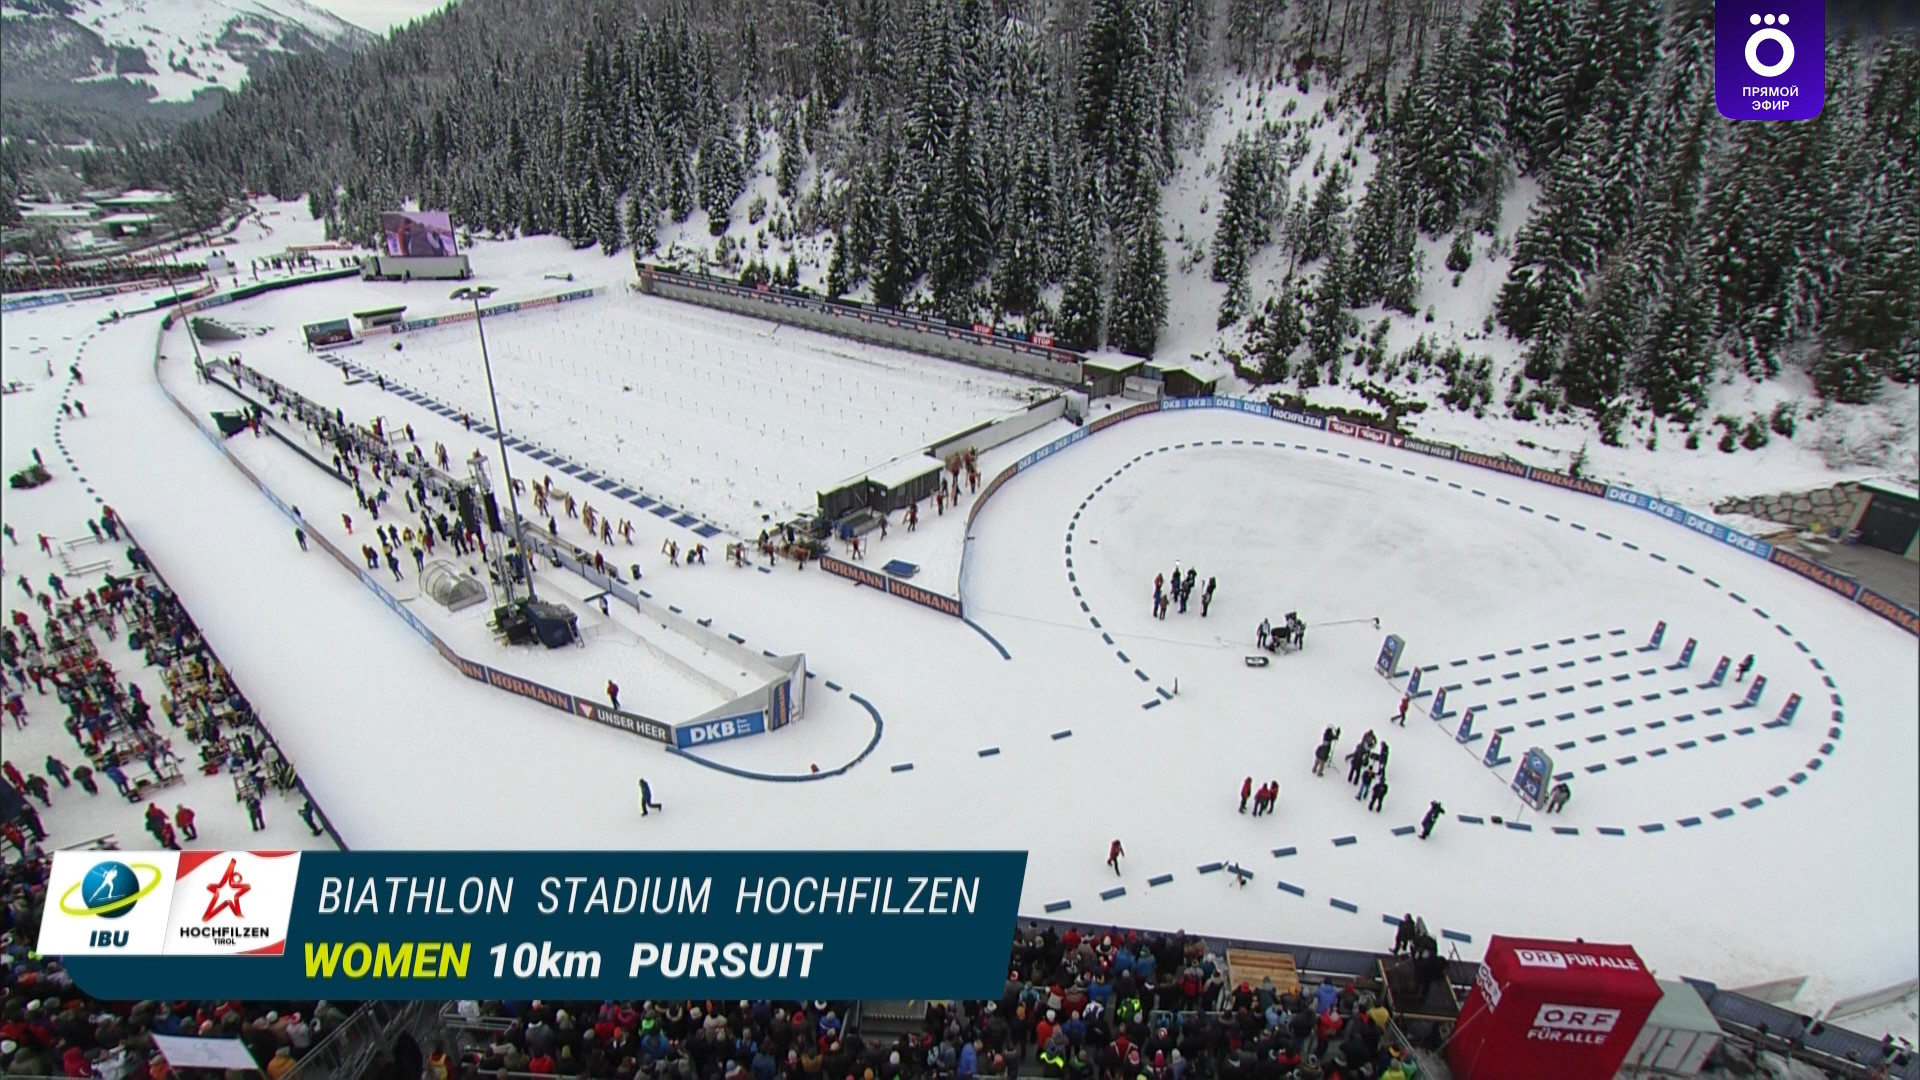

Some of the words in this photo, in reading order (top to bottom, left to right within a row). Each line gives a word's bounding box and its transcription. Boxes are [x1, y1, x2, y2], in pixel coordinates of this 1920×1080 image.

[974, 325, 990, 334] STOP
[1033, 337, 1050, 346] STOP
[1163, 400, 1180, 409] DKB
[1188, 400, 1206, 408] DKB
[1216, 398, 1236, 409] DKB
[1244, 402, 1262, 414] DKB
[1273, 409, 1322, 428] HOCHFILZEN
[1404, 441, 1430, 454] UNSER
[1430, 446, 1451, 458] HEER
[1608, 489, 1637, 505] DKB
[1649, 500, 1675, 518] DKB
[1686, 515, 1715, 535] DKB
[1727, 531, 1756, 551] DKB
[597, 709, 634, 730] UNSER
[636, 721, 666, 741] HEER
[690, 720, 736, 743] DKB
[1521, 951, 1561, 963] ORF
[1566, 952, 1599, 966] FÜR
[1600, 956, 1640, 971] ALLE
[1543, 1009, 1612, 1026] ORF
[1527, 1027, 1561, 1041] FÜR
[1563, 1030, 1607, 1044] ALLE
